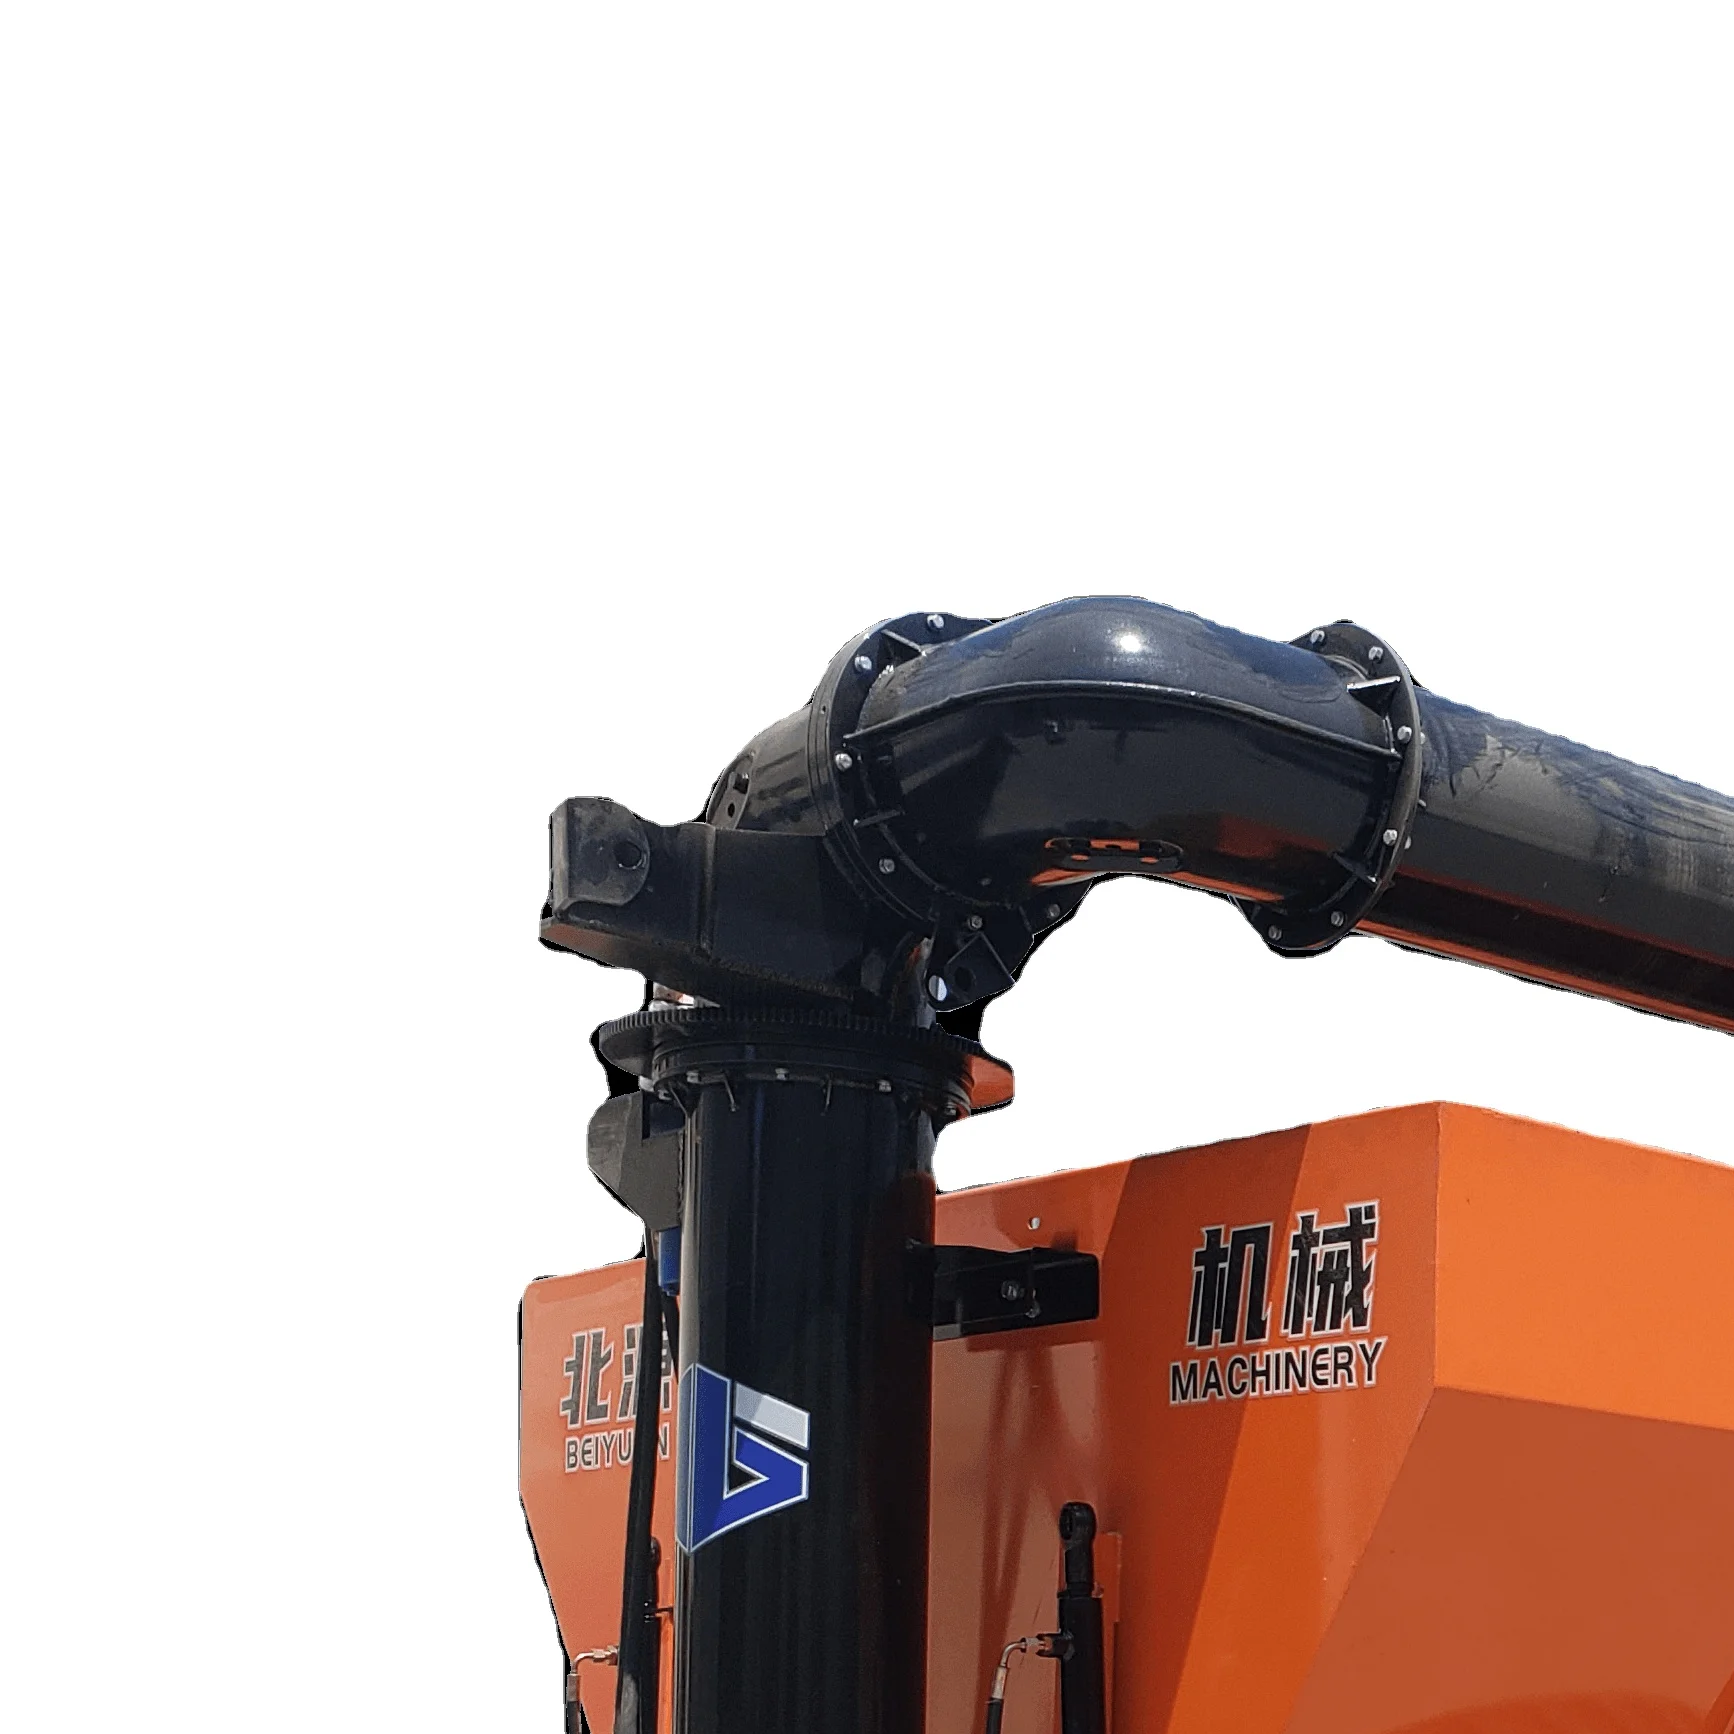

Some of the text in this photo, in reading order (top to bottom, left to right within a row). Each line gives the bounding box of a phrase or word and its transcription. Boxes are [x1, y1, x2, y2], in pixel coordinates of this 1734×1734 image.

[1186, 1200, 1379, 1350] 机械
[1170, 1336, 1388, 1406] MACHINERY
[565, 1422, 670, 1473] BEIYUN
